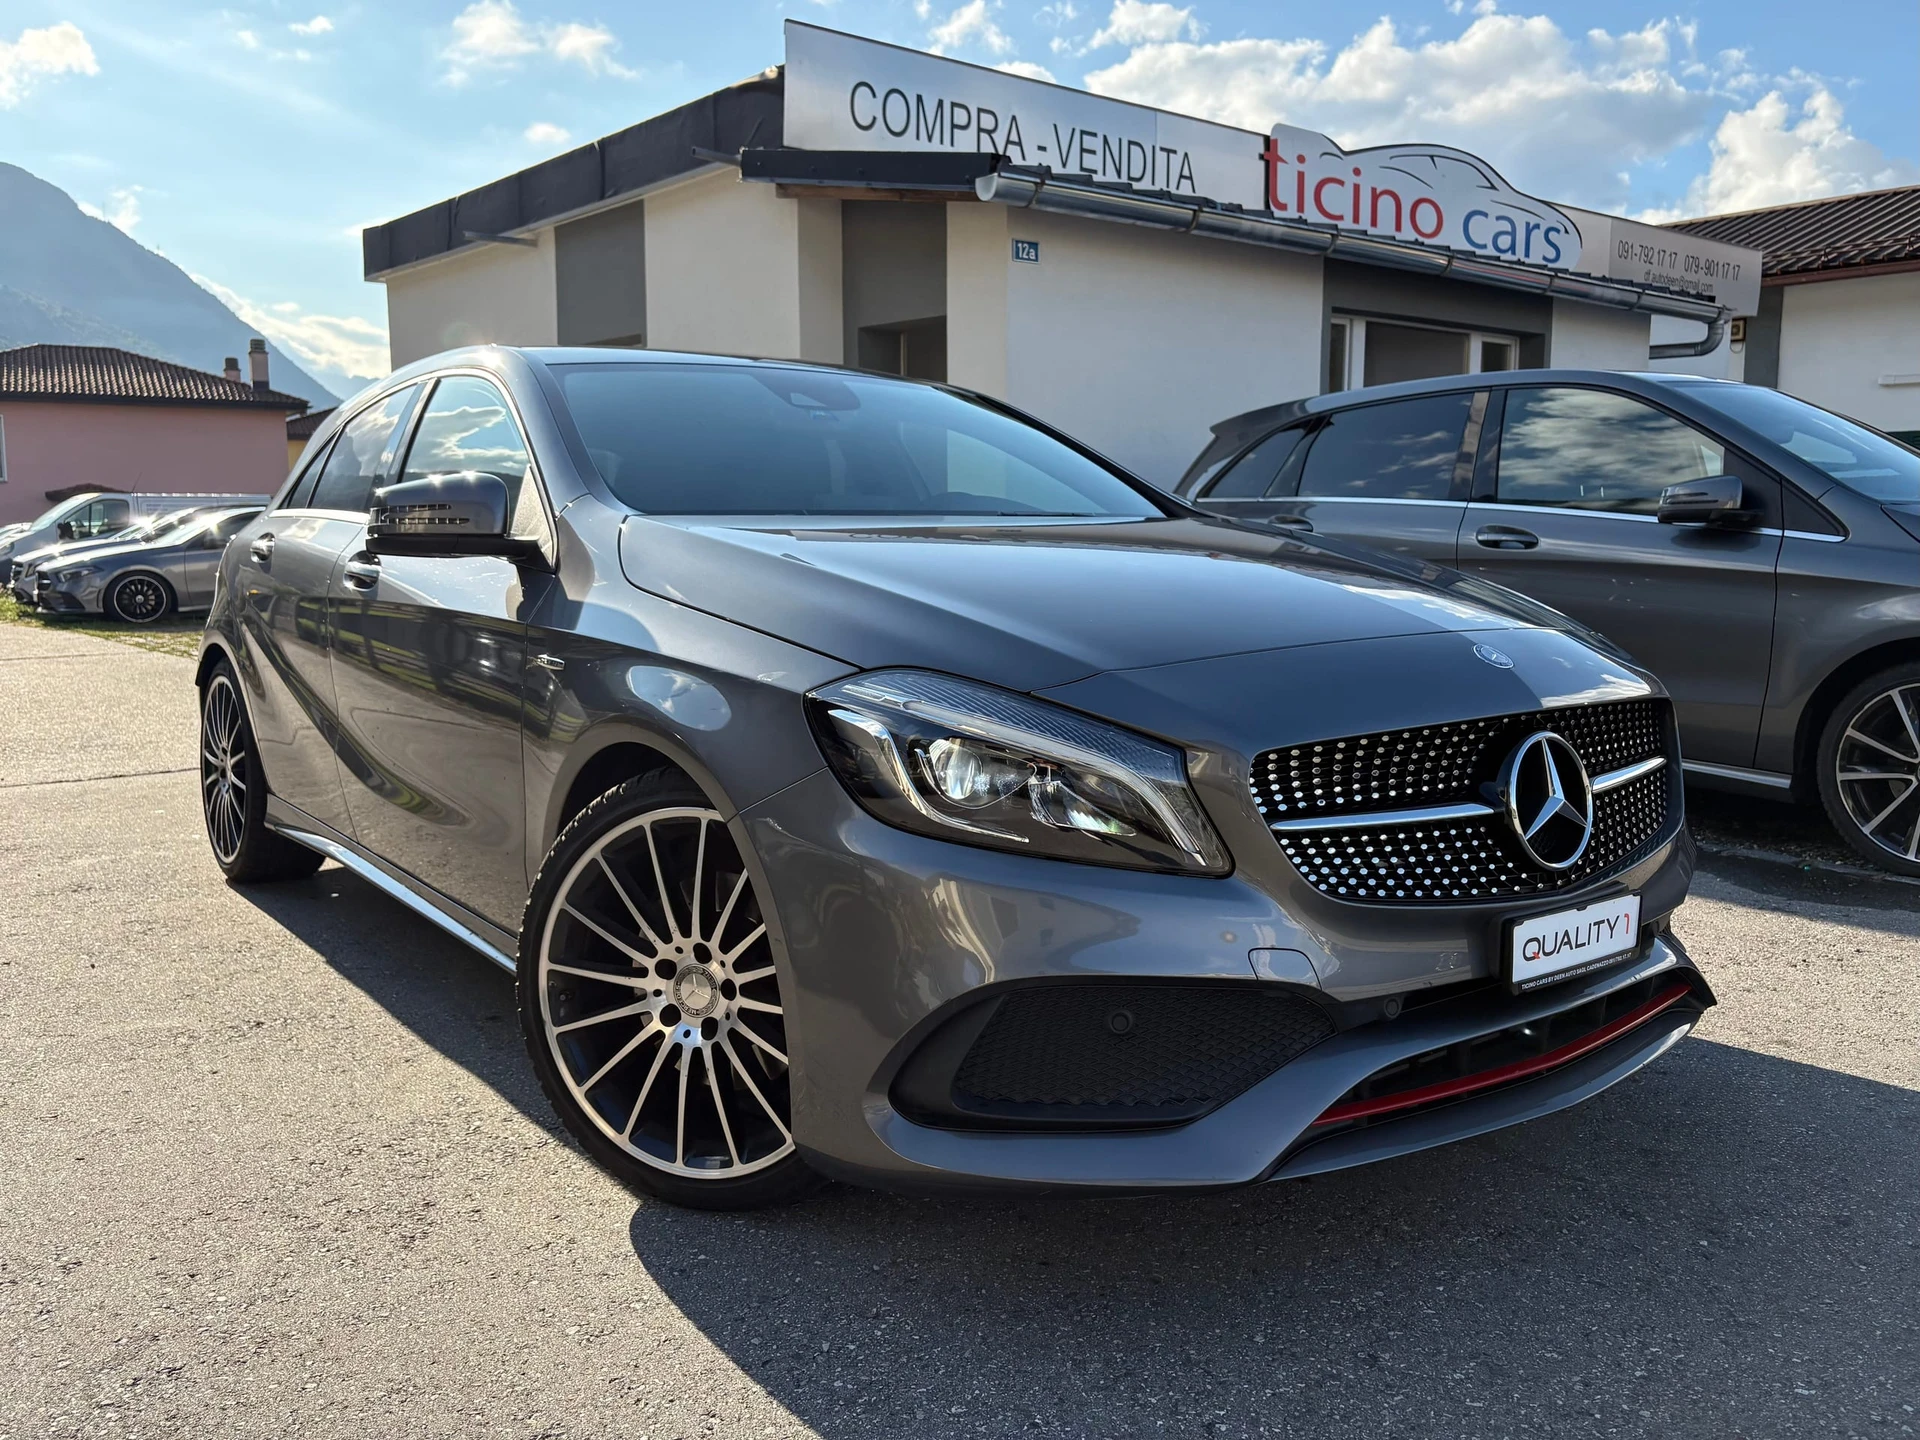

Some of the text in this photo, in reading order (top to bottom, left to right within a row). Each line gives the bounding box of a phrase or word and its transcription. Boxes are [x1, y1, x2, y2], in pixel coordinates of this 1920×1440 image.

[850, 81, 1026, 161] COMPRA
[1053, 123, 1196, 194] VENDITA
[1264, 138, 1561, 264] ticino cars
[1017, 243, 1036, 260] 12a
[1618, 240, 1653, 265] 091-792
[1522, 913, 1630, 962] QUALITY 1
[1537, 977, 1548, 986] CARS
